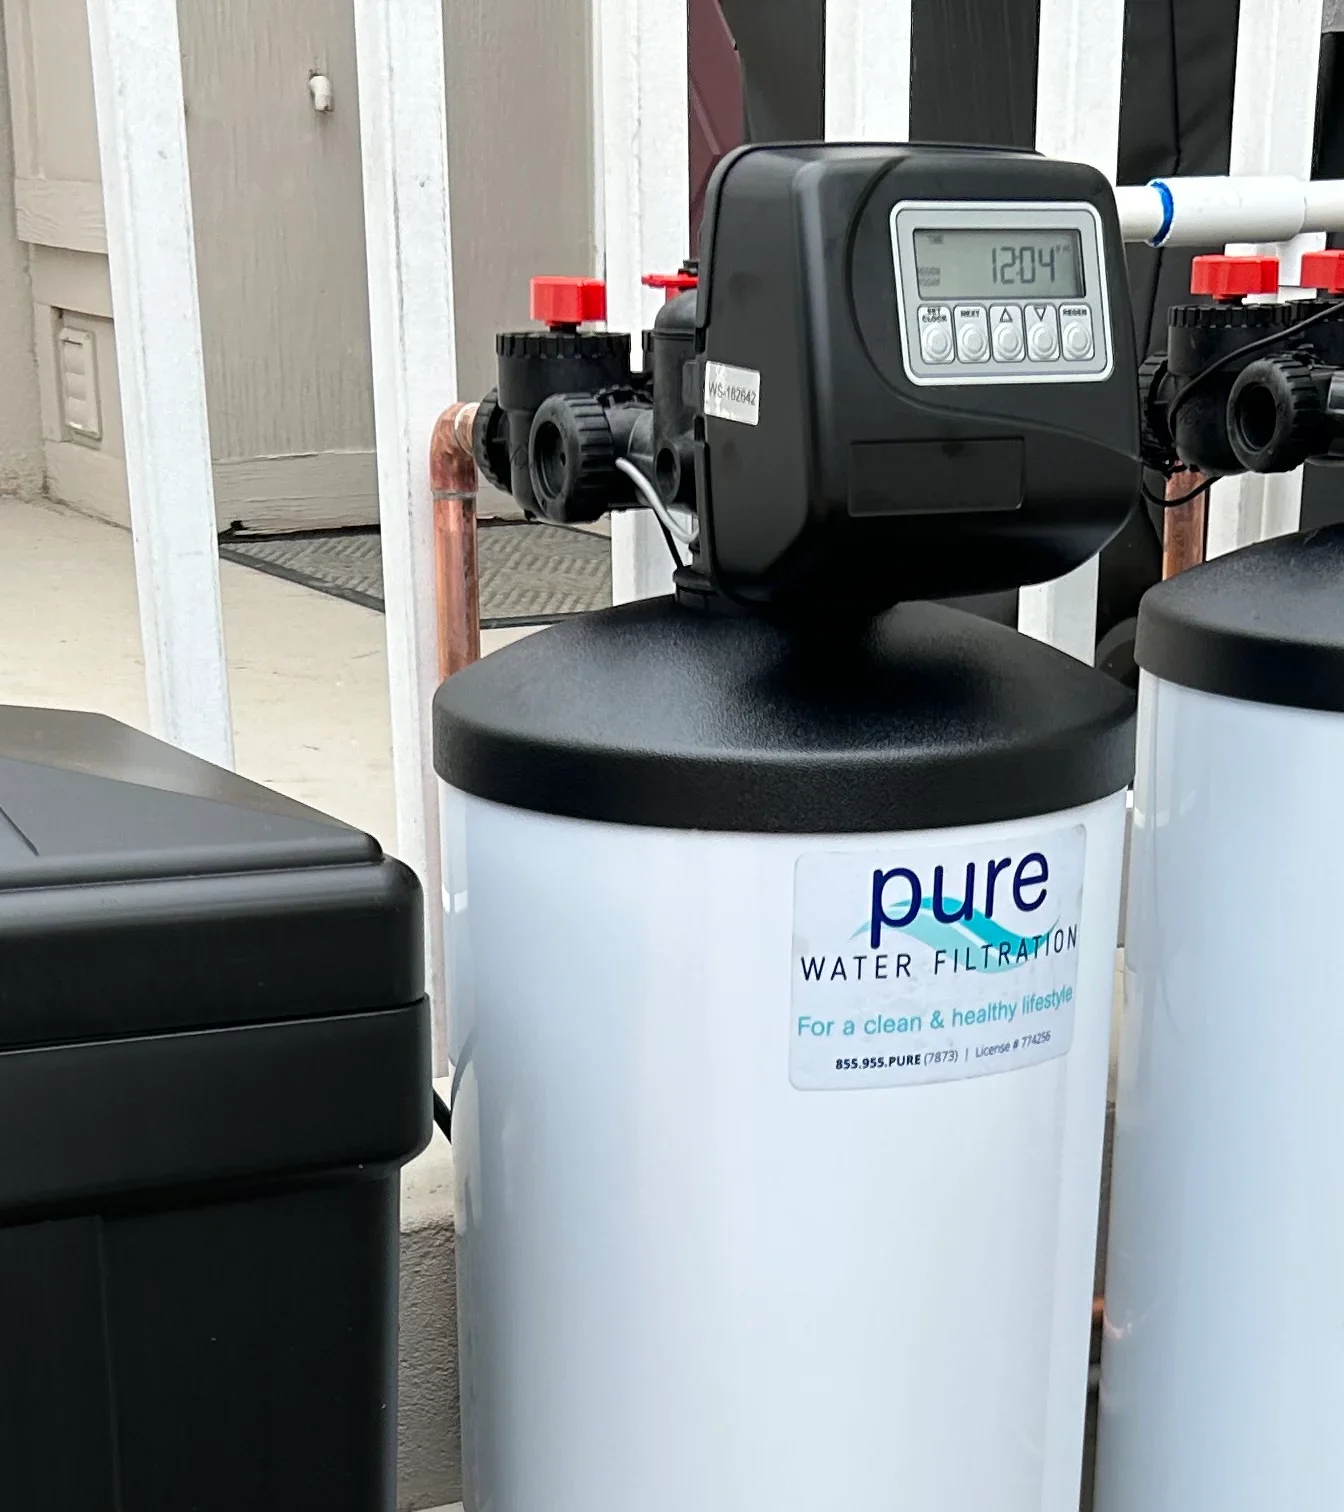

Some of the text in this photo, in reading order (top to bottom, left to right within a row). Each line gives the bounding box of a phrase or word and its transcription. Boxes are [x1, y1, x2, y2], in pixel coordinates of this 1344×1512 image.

[922, 314, 947, 323] CLOCK
[960, 309, 980, 317] NEXT
[871, 852, 1049, 949] pure
[801, 924, 1077, 982] WATER FILTRATION
[798, 984, 1073, 1037] For a clean & healthy lifestyle
[835, 1053, 921, 1070] 855.955.PURE
[923, 1050, 959, 1067] (7873)
[975, 1042, 1010, 1058] License
